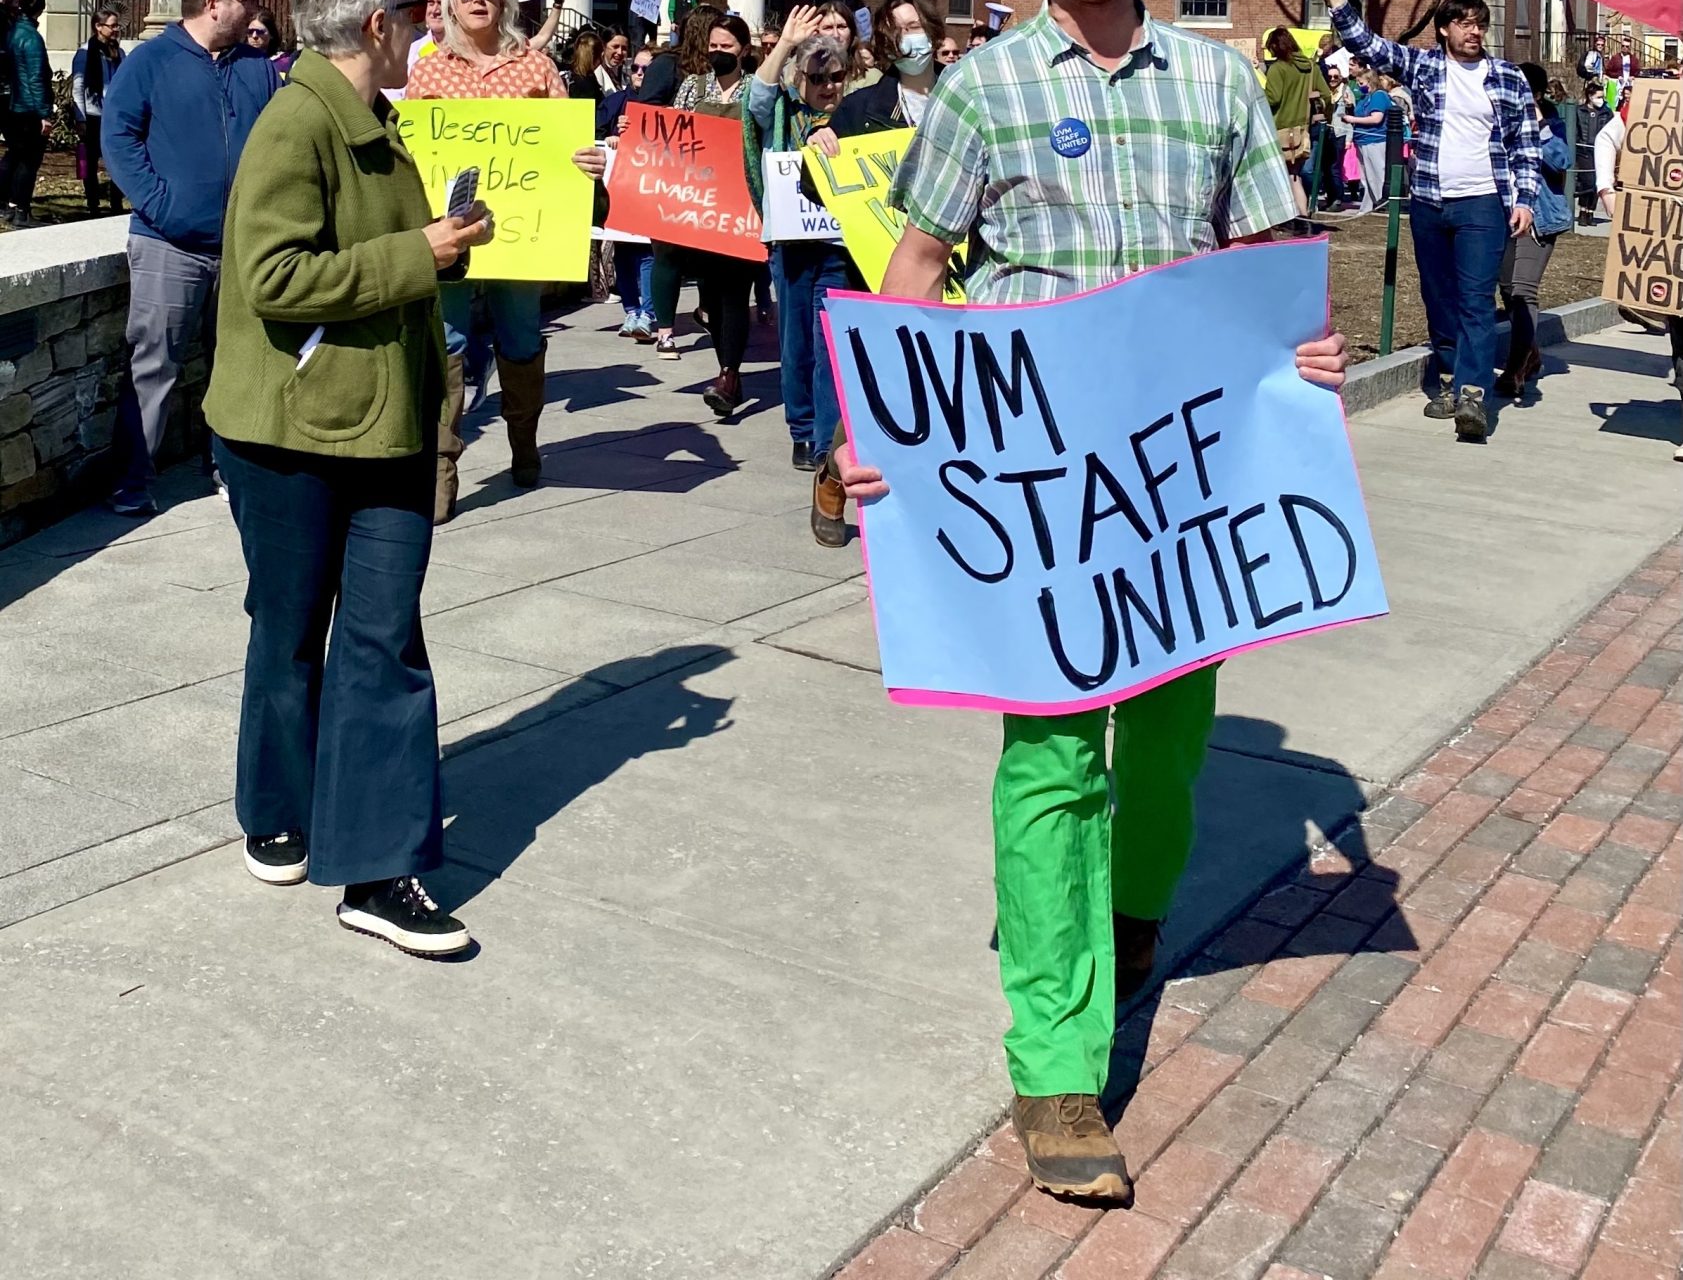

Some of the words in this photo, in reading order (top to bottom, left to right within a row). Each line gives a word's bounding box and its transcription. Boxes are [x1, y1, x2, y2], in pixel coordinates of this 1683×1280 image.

[1643, 88, 1683, 123] FA
[398, 119, 414, 138] e
[431, 107, 541, 146] Deserve
[641, 111, 695, 144] UVM
[1053, 127, 1072, 137] UVM
[1056, 132, 1079, 144] STAFF
[1058, 137, 1088, 150] UNITED
[1626, 121, 1683, 156] CON
[631, 140, 705, 168] STAFF
[1638, 154, 1683, 190] NO
[639, 173, 717, 207] LIVABLE
[802, 217, 842, 232] WAG
[846, 325, 1066, 455] UVM
[936, 387, 1224, 583] STAFF
[1037, 494, 1356, 691] UNITED
